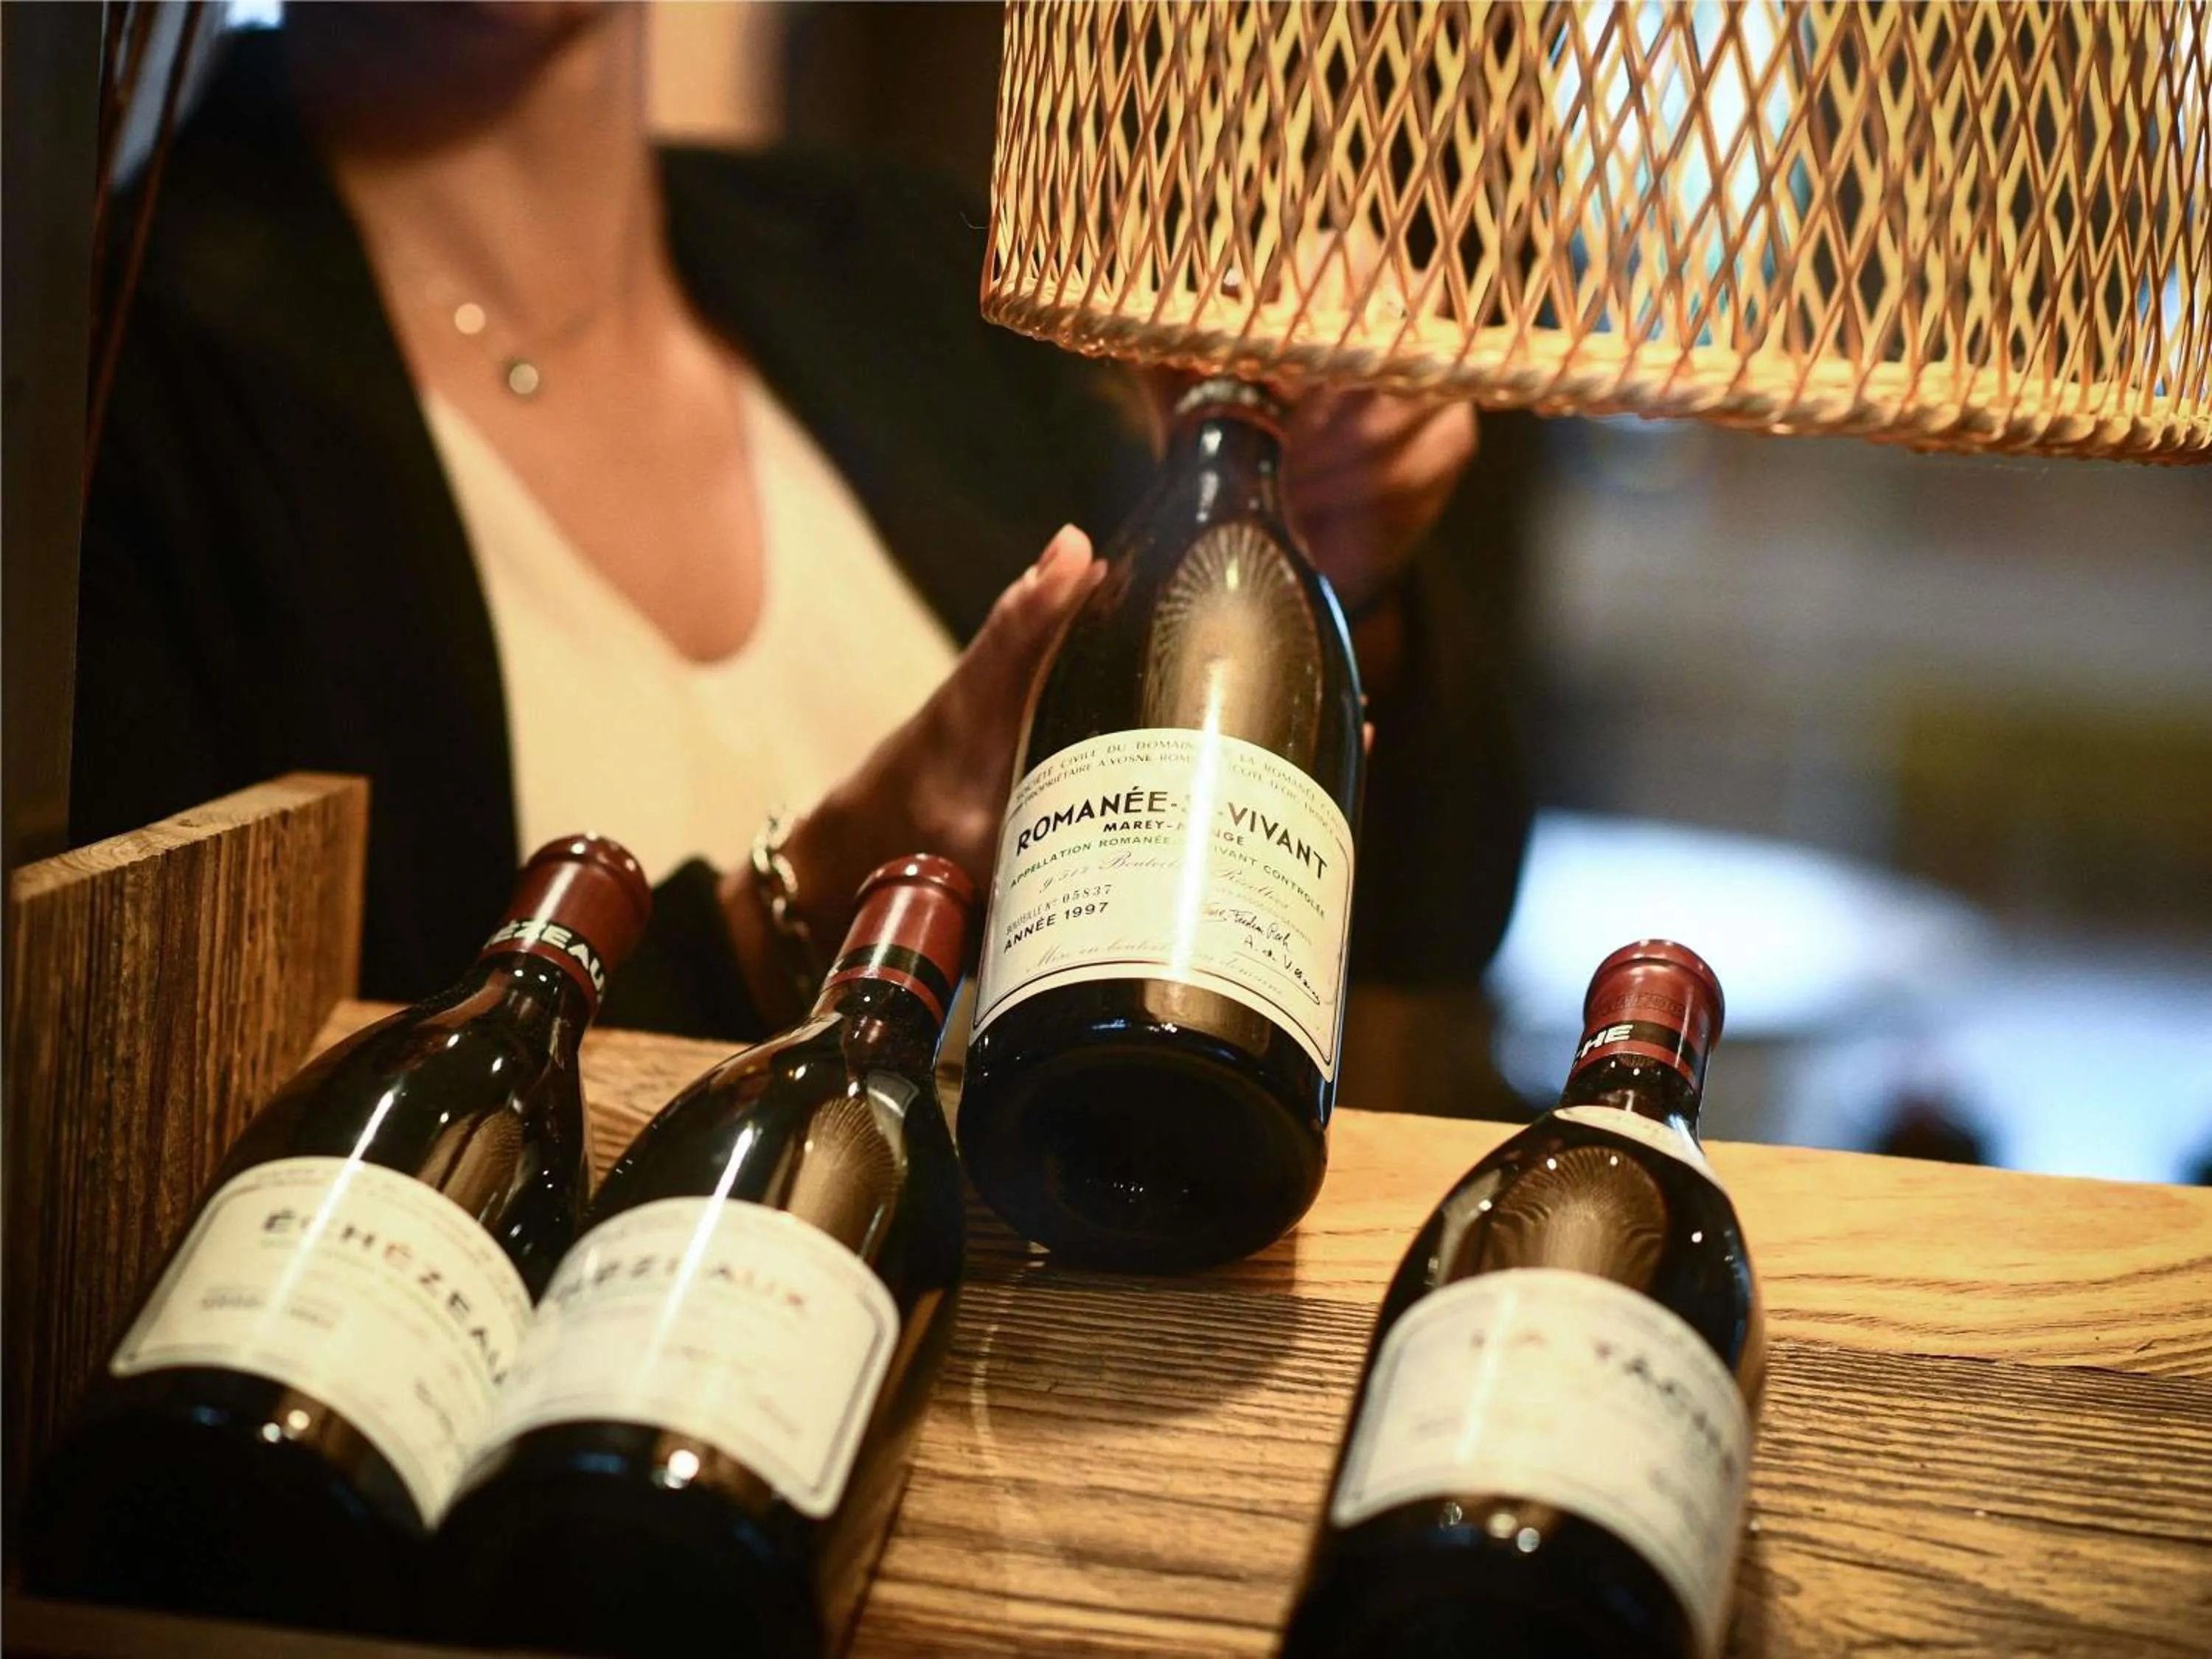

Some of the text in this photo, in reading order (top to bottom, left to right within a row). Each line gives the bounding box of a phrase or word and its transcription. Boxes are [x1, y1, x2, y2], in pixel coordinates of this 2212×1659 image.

[1107, 742, 1127, 754] DU
[1136, 740, 1196, 751] DOMAIN
[1010, 842, 1093, 888] APPELLATION
[1062, 884, 1112, 904] 05837
[1004, 902, 1110, 953] ANNÉE 1997
